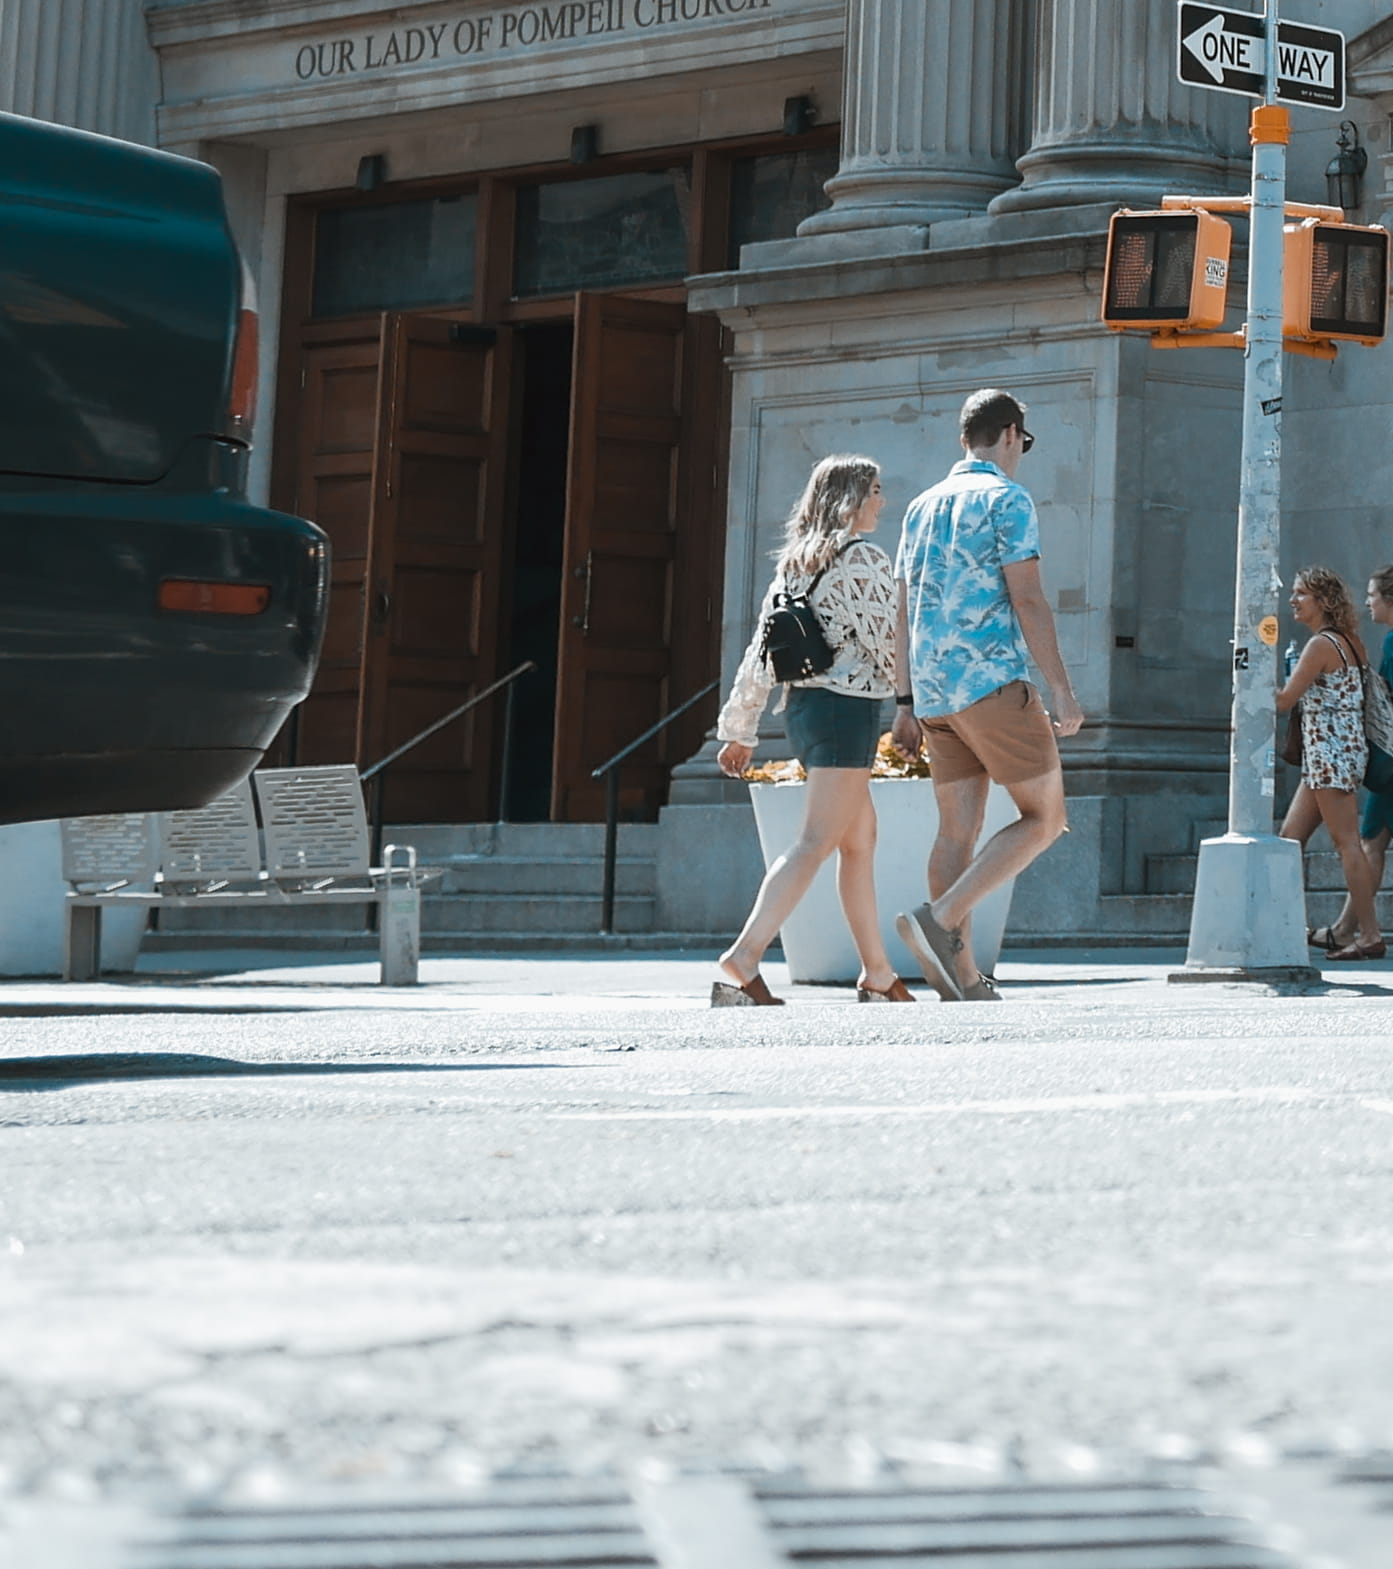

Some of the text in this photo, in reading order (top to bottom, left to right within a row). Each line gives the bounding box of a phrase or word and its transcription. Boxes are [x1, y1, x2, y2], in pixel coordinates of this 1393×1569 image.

[296, 40, 356, 80] OUR
[364, 23, 447, 70] LADY
[454, 17, 493, 55] OF
[1203, 32, 1328, 81] ONE WAY
